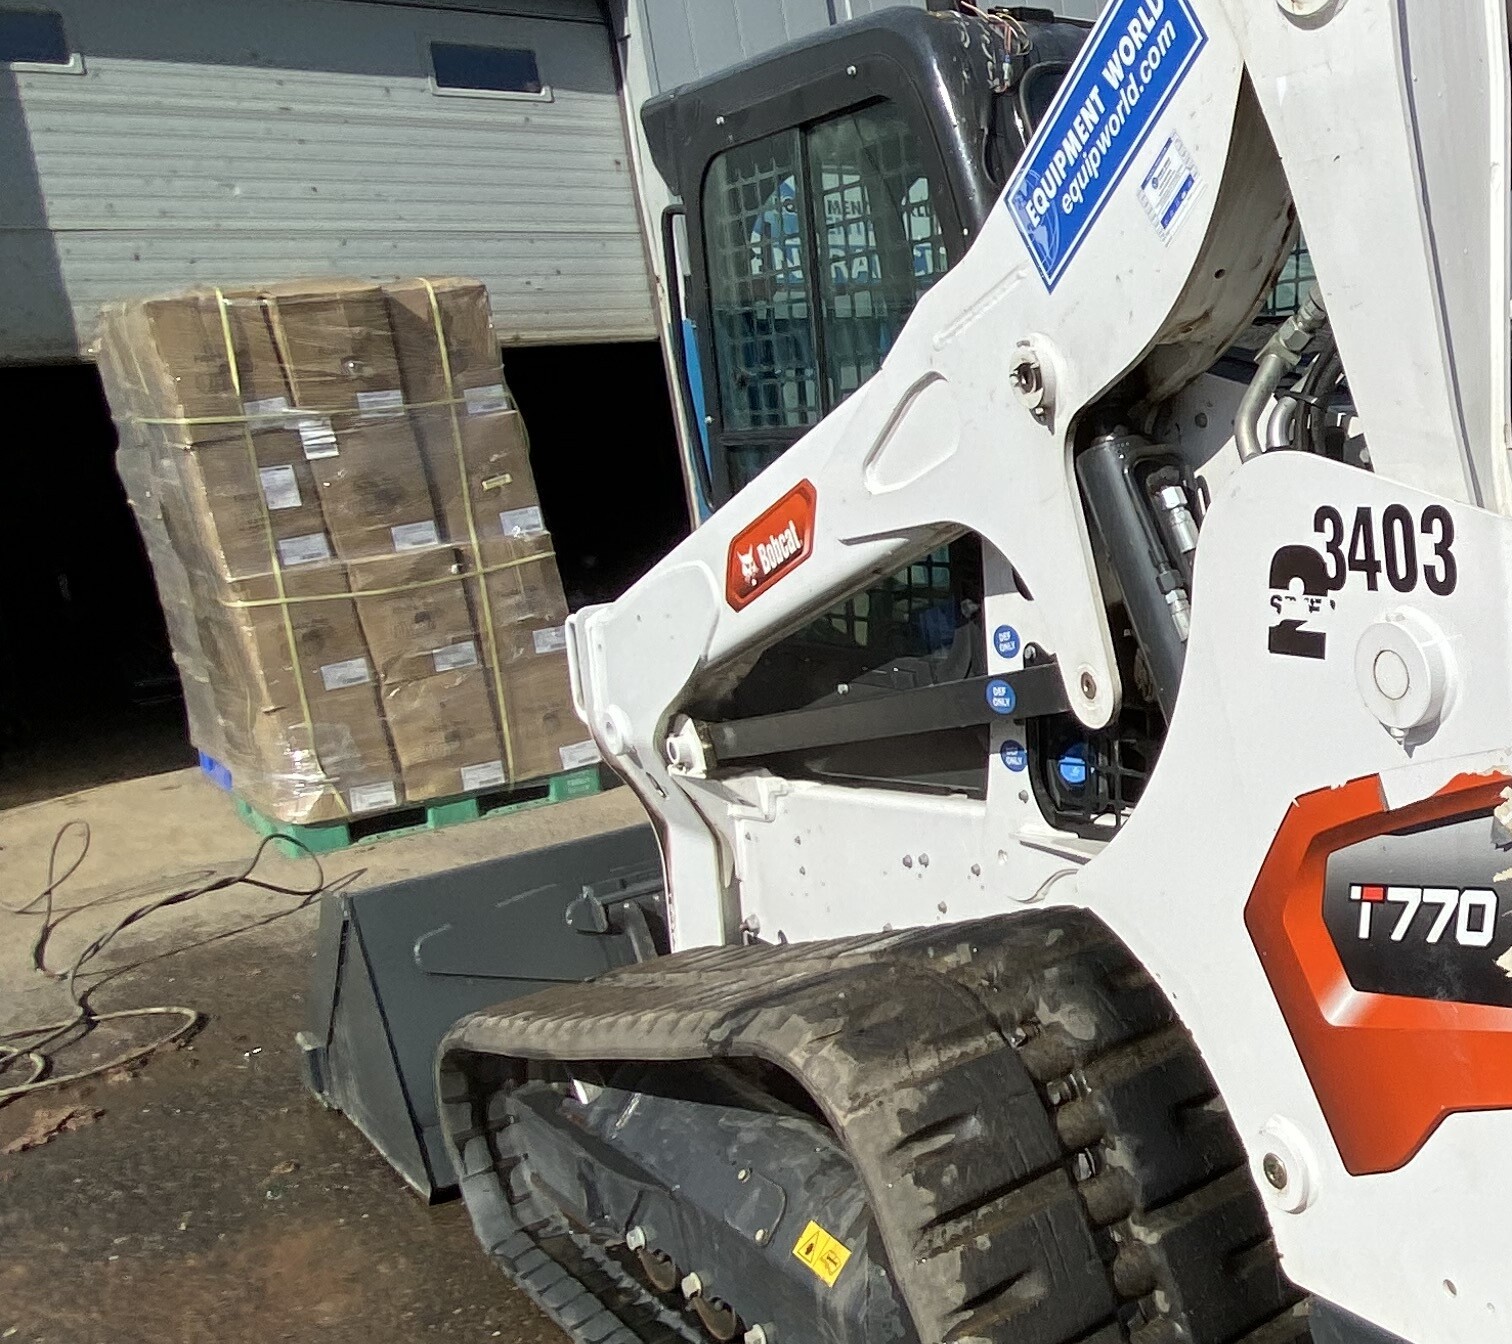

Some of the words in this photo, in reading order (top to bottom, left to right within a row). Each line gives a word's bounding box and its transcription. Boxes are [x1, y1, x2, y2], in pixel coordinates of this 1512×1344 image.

[1025, 85, 1106, 228] EQUIPMENT
[1061, 19, 1177, 215] equipworld.com
[756, 519, 802, 575] Bobcat
[1313, 503, 1458, 597] 3403
[1350, 884, 1499, 948] T770
